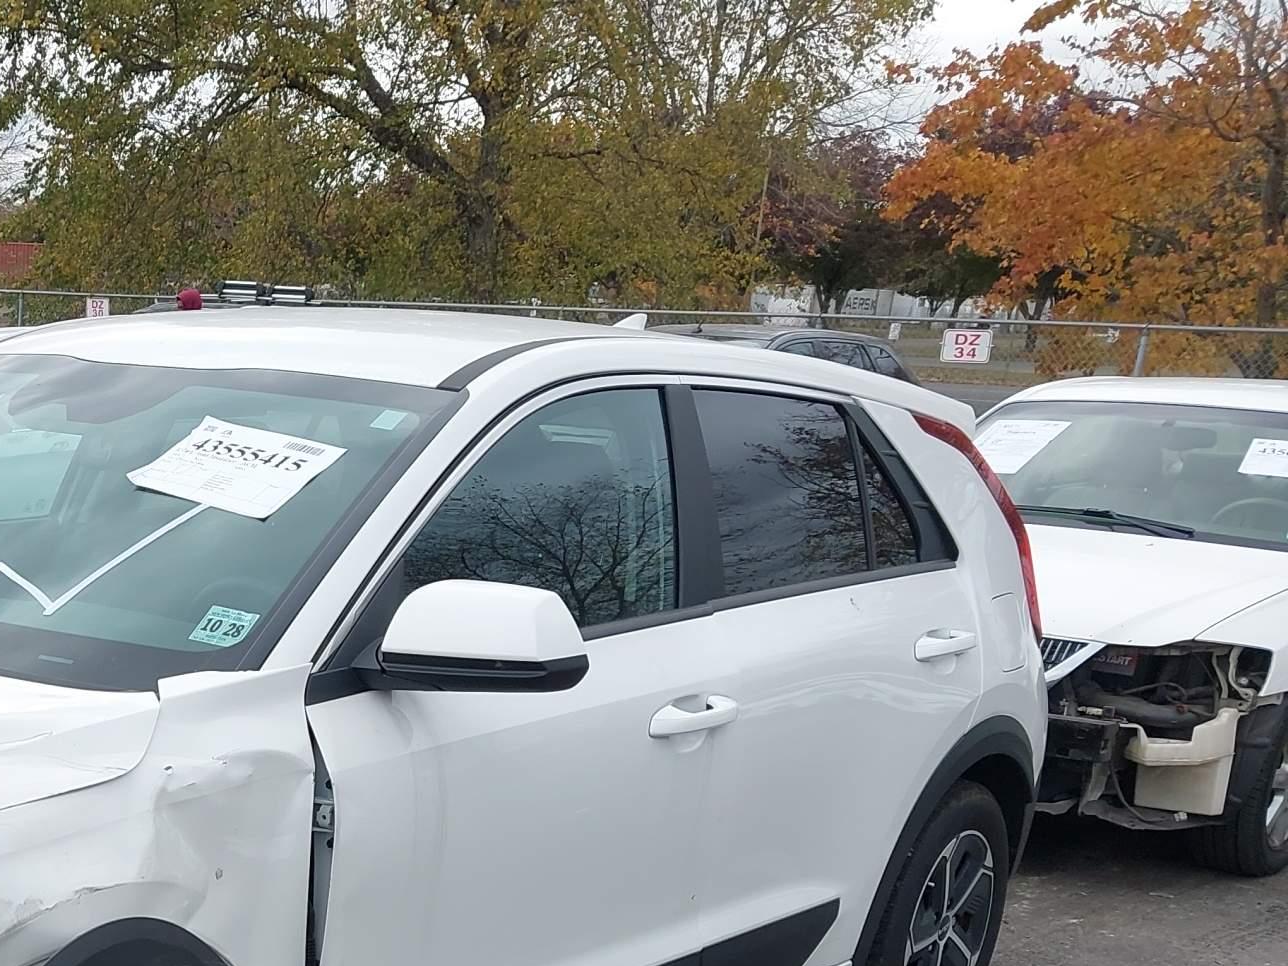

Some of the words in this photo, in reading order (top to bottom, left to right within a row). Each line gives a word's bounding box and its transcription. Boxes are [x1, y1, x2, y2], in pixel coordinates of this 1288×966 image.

[91, 300, 105, 309] DZ
[845, 296, 877, 311] AERSK
[954, 333, 982, 346] DZ
[953, 346, 977, 359] 34
[192, 438, 309, 472] 43555415
[199, 617, 224, 633] 10
[222, 622, 246, 638] 28
[1096, 654, 1134, 665] START
